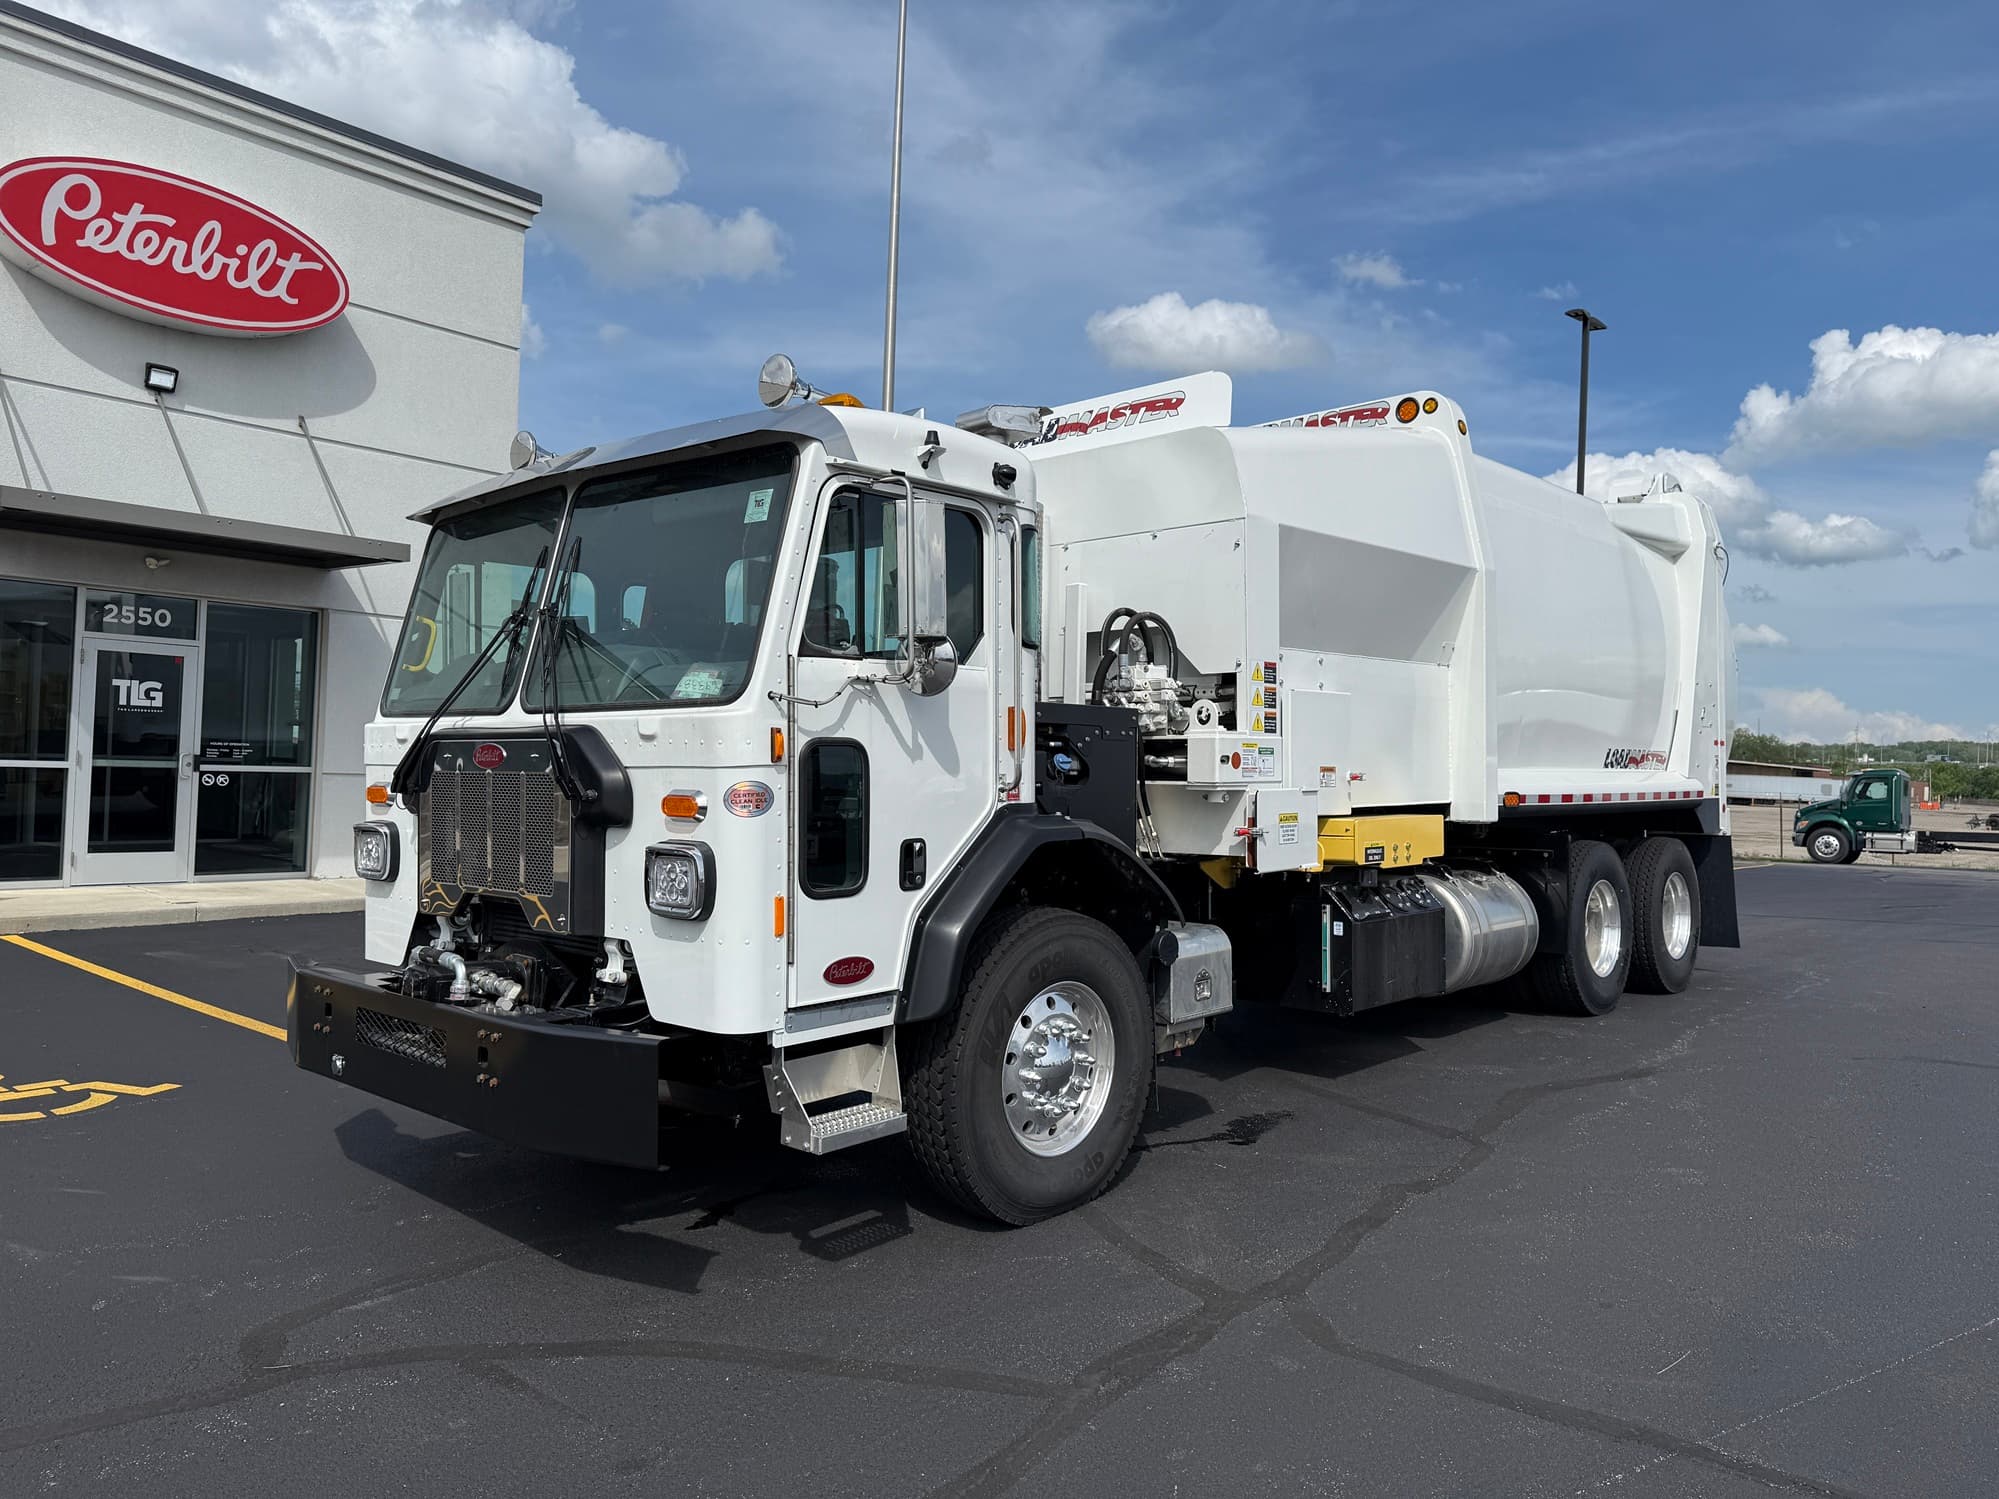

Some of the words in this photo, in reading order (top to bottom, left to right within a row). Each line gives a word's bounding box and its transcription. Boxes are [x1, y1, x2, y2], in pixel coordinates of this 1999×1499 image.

[41, 173, 323, 305] Peterbilt
[1010, 391, 1186, 449] DMASTER
[103, 604, 172, 627] 2550
[112, 679, 163, 707] TLG
[829, 961, 871, 980] Peterbilt
